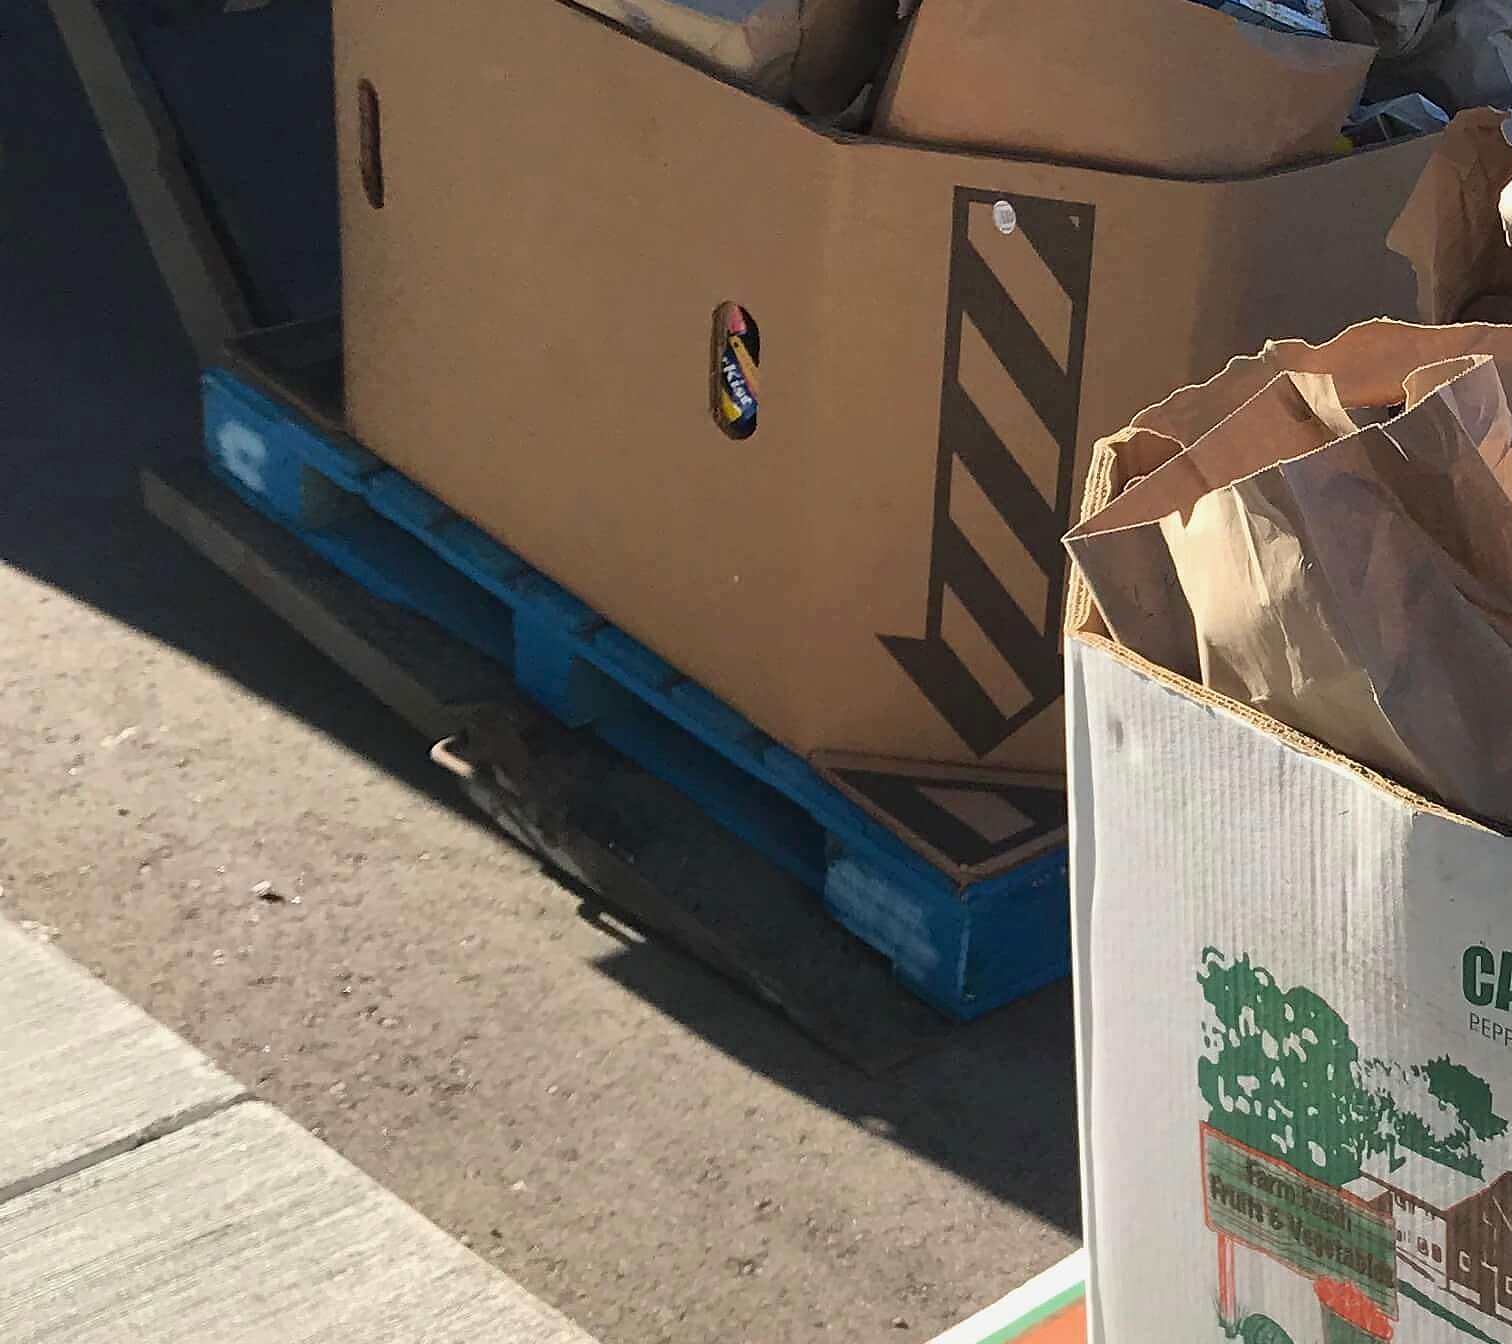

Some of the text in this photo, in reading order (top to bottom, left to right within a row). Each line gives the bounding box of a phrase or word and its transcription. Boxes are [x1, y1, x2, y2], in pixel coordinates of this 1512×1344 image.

[1209, 1174, 1265, 1223] Fruits
[1267, 1207, 1284, 1231] &
[1247, 1159, 1297, 1203] Farm
